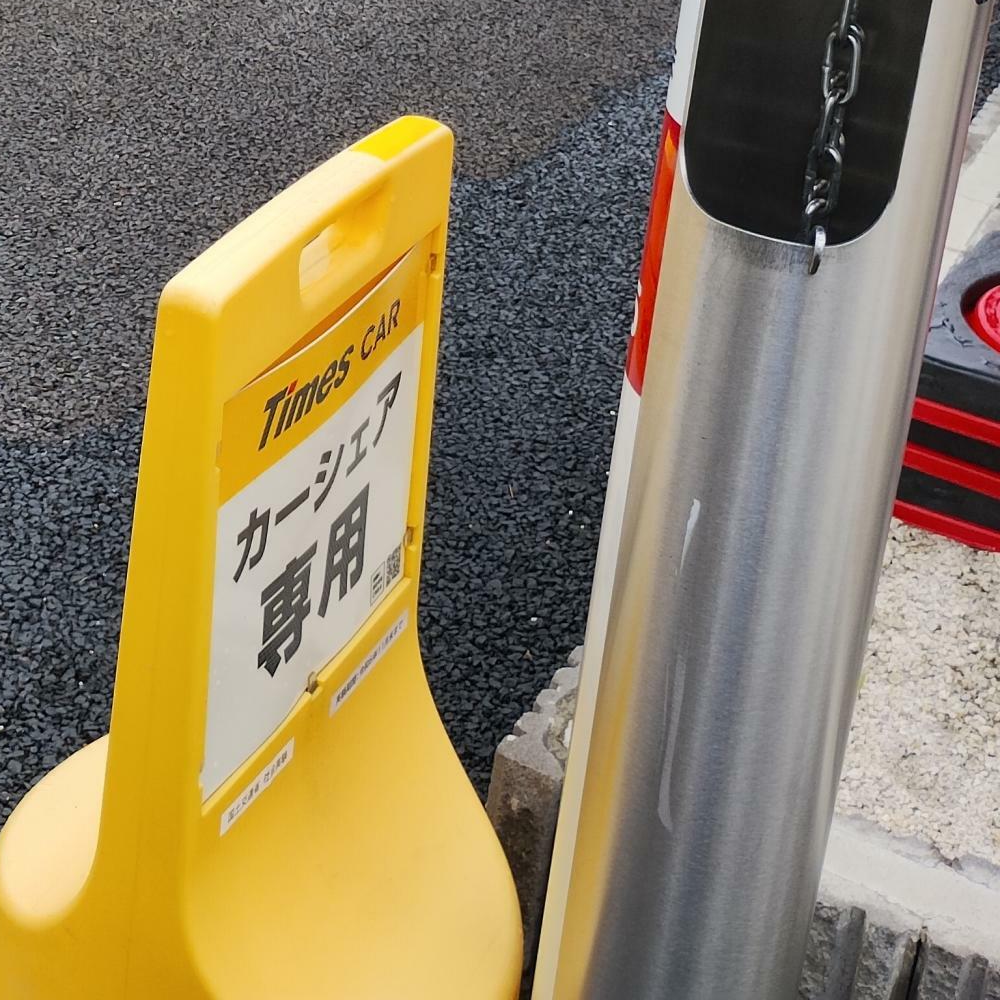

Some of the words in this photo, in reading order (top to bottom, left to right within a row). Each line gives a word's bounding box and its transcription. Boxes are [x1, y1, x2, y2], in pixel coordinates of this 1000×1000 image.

[258, 344, 355, 452] Times
[360, 298, 401, 361] CAR
[233, 370, 402, 583] カーシェア
[257, 482, 370, 678] 専用
